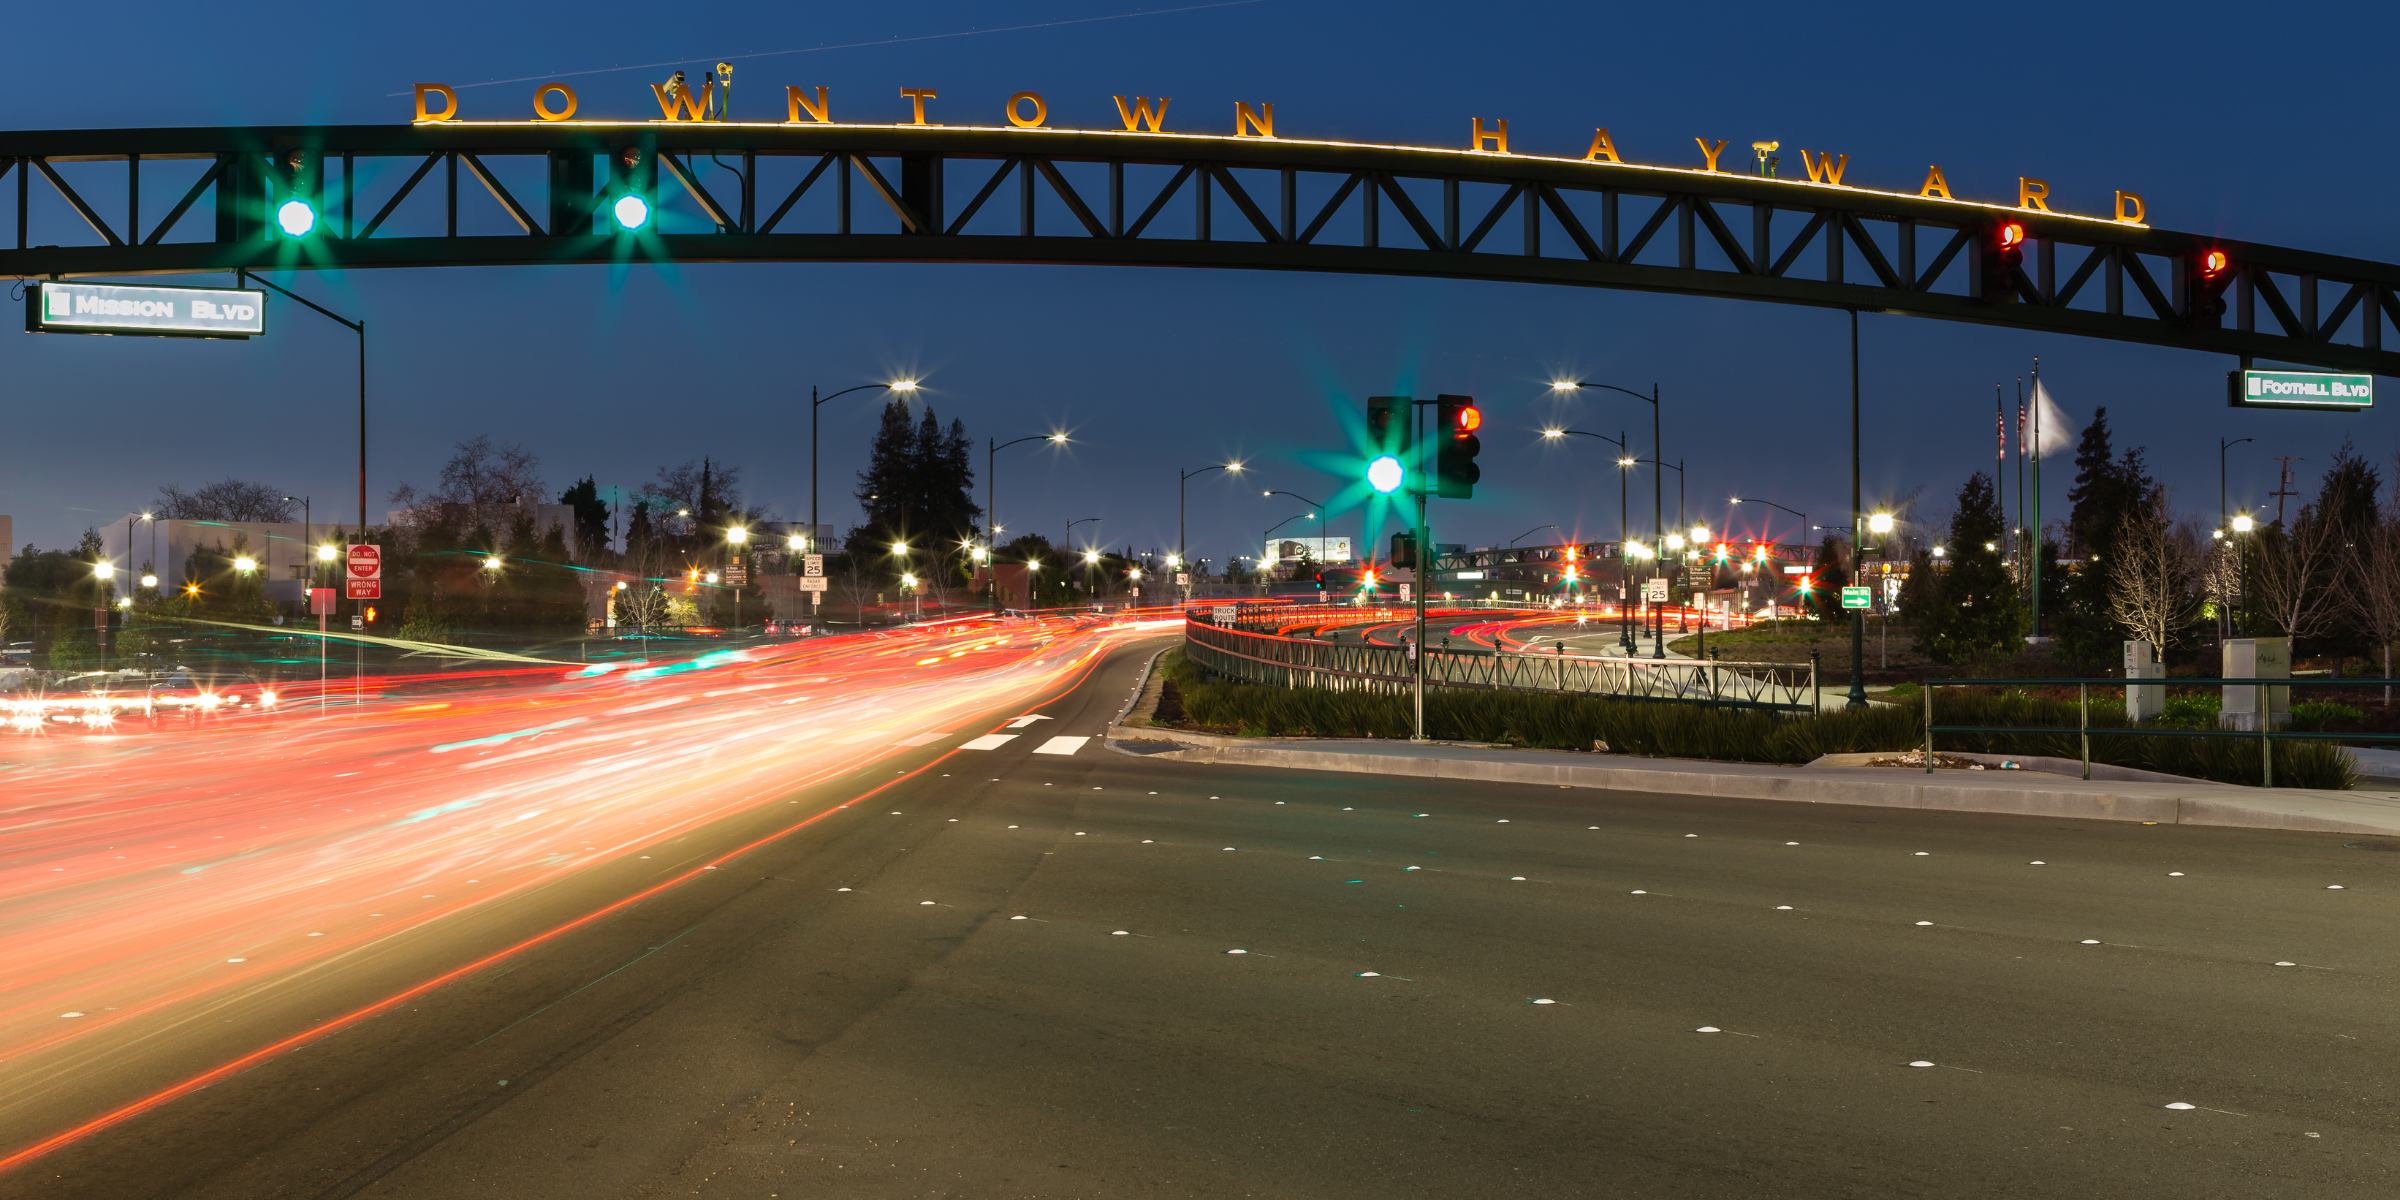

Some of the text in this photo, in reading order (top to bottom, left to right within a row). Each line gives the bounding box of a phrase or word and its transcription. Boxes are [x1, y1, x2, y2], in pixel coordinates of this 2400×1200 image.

[412, 82, 2147, 226] DOWNTOWN HAYWARD
[807, 566, 820, 574] 25
[1652, 591, 1665, 599] 25
